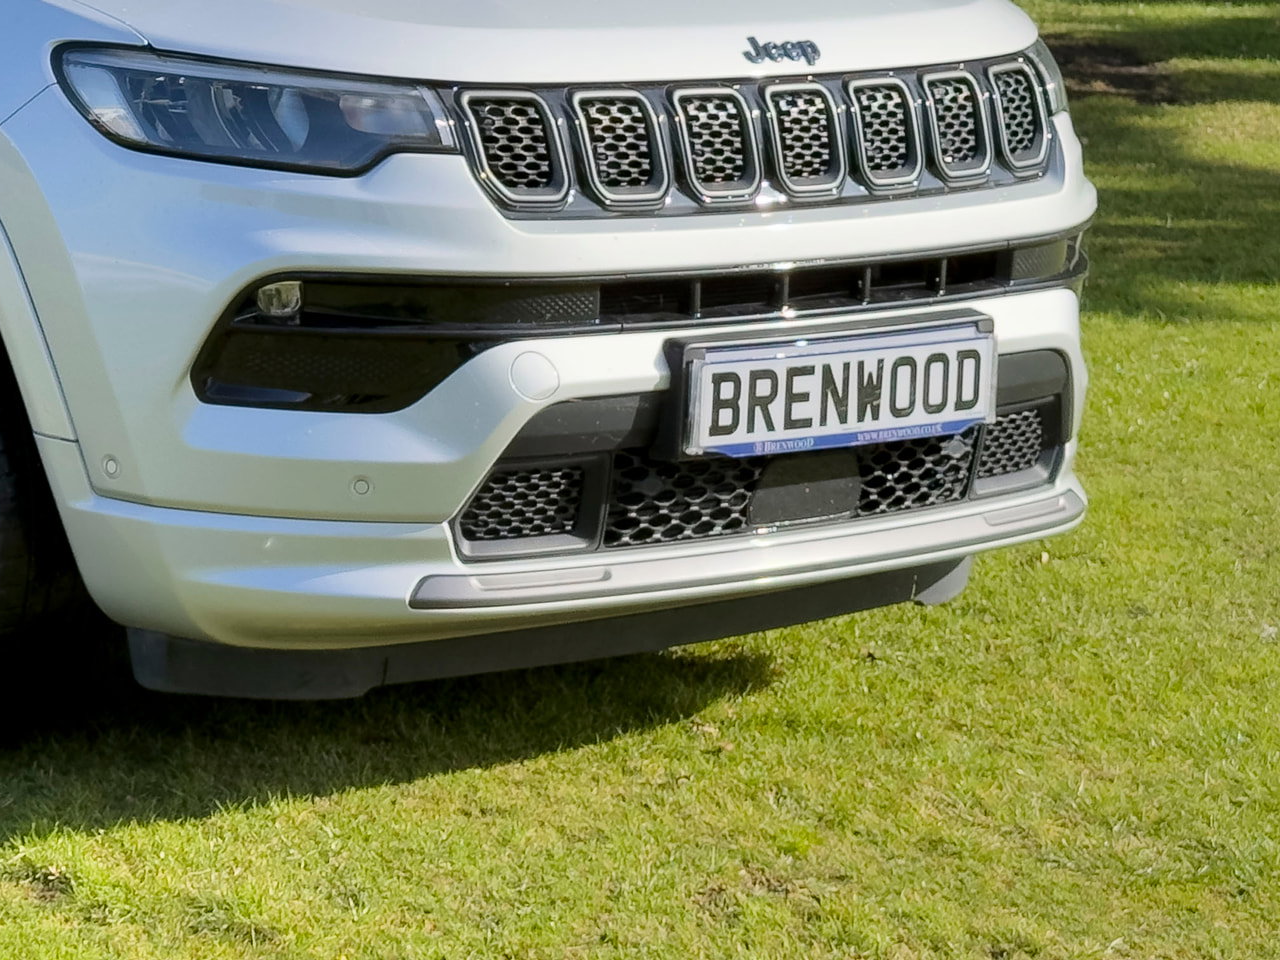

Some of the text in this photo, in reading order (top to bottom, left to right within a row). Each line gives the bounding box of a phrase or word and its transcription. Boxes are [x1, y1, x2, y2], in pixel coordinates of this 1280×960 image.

[742, 36, 820, 66] Jeep
[708, 349, 982, 437] BRENWOOD
[764, 438, 815, 453] BRENWOOD
